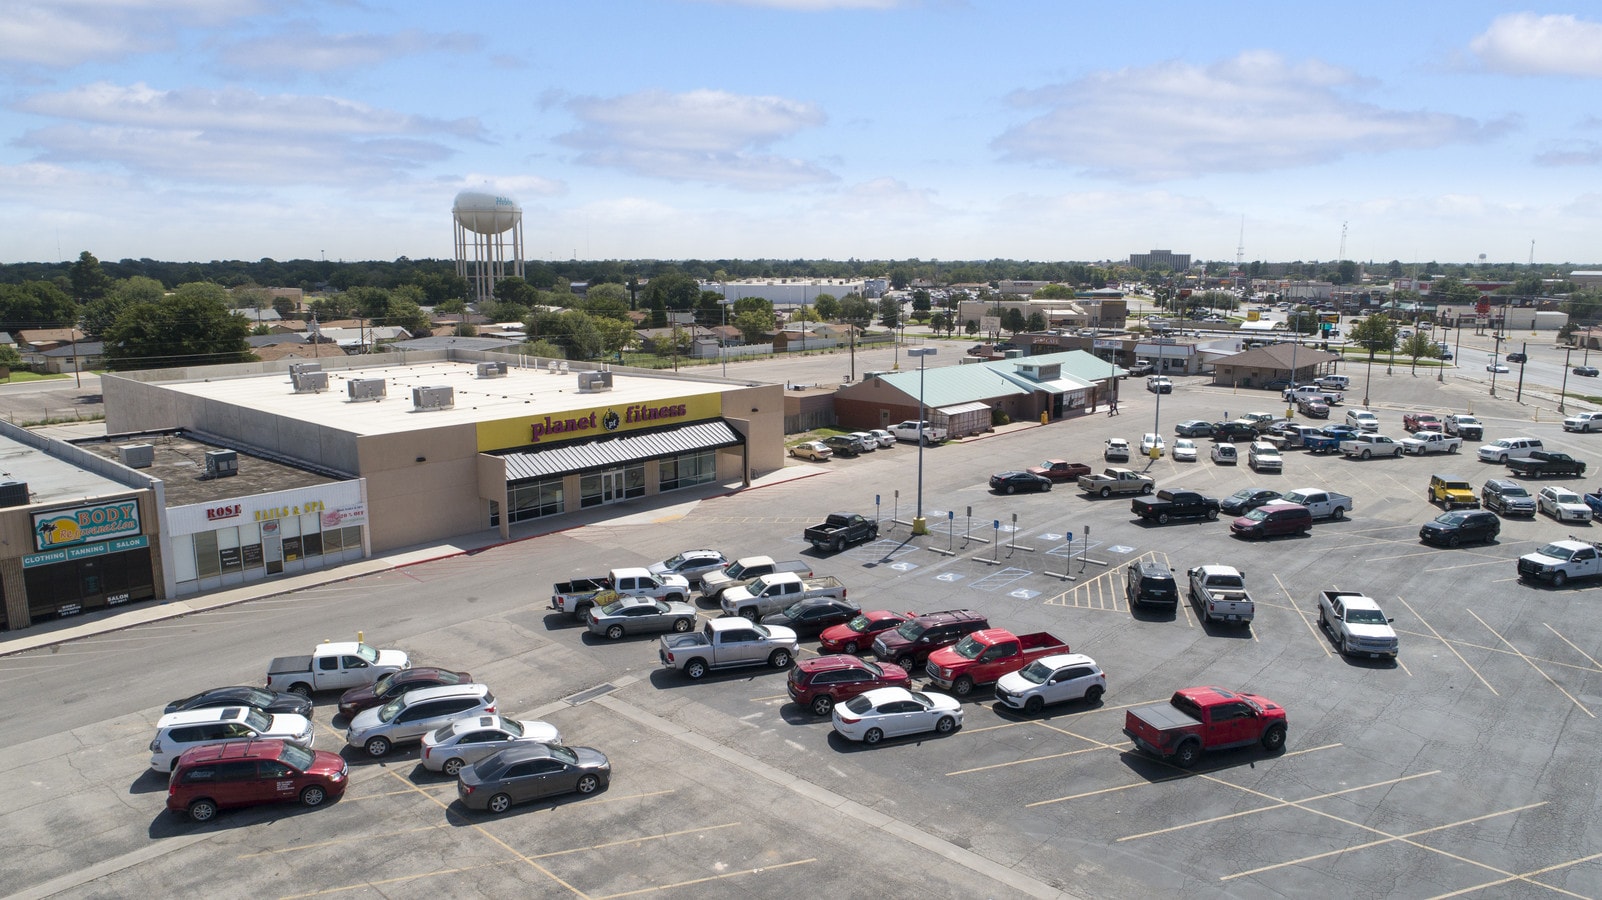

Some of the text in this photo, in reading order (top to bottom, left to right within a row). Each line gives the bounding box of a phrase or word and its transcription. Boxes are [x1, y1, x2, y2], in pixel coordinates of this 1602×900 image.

[531, 403, 687, 442] planet fitness
[608, 419, 617, 429] pf
[78, 506, 133, 527] BODY
[206, 504, 242, 519] ROSE
[254, 507, 289, 521] NAILS
[293, 505, 300, 515] &
[304, 500, 326, 513] SPA
[60, 518, 135, 540] Rejuvenation
[116, 539, 140, 549] SALON
[71, 545, 104, 556] TANNING
[24, 552, 65, 564] CLOTHING
[107, 593, 129, 602] SALON
